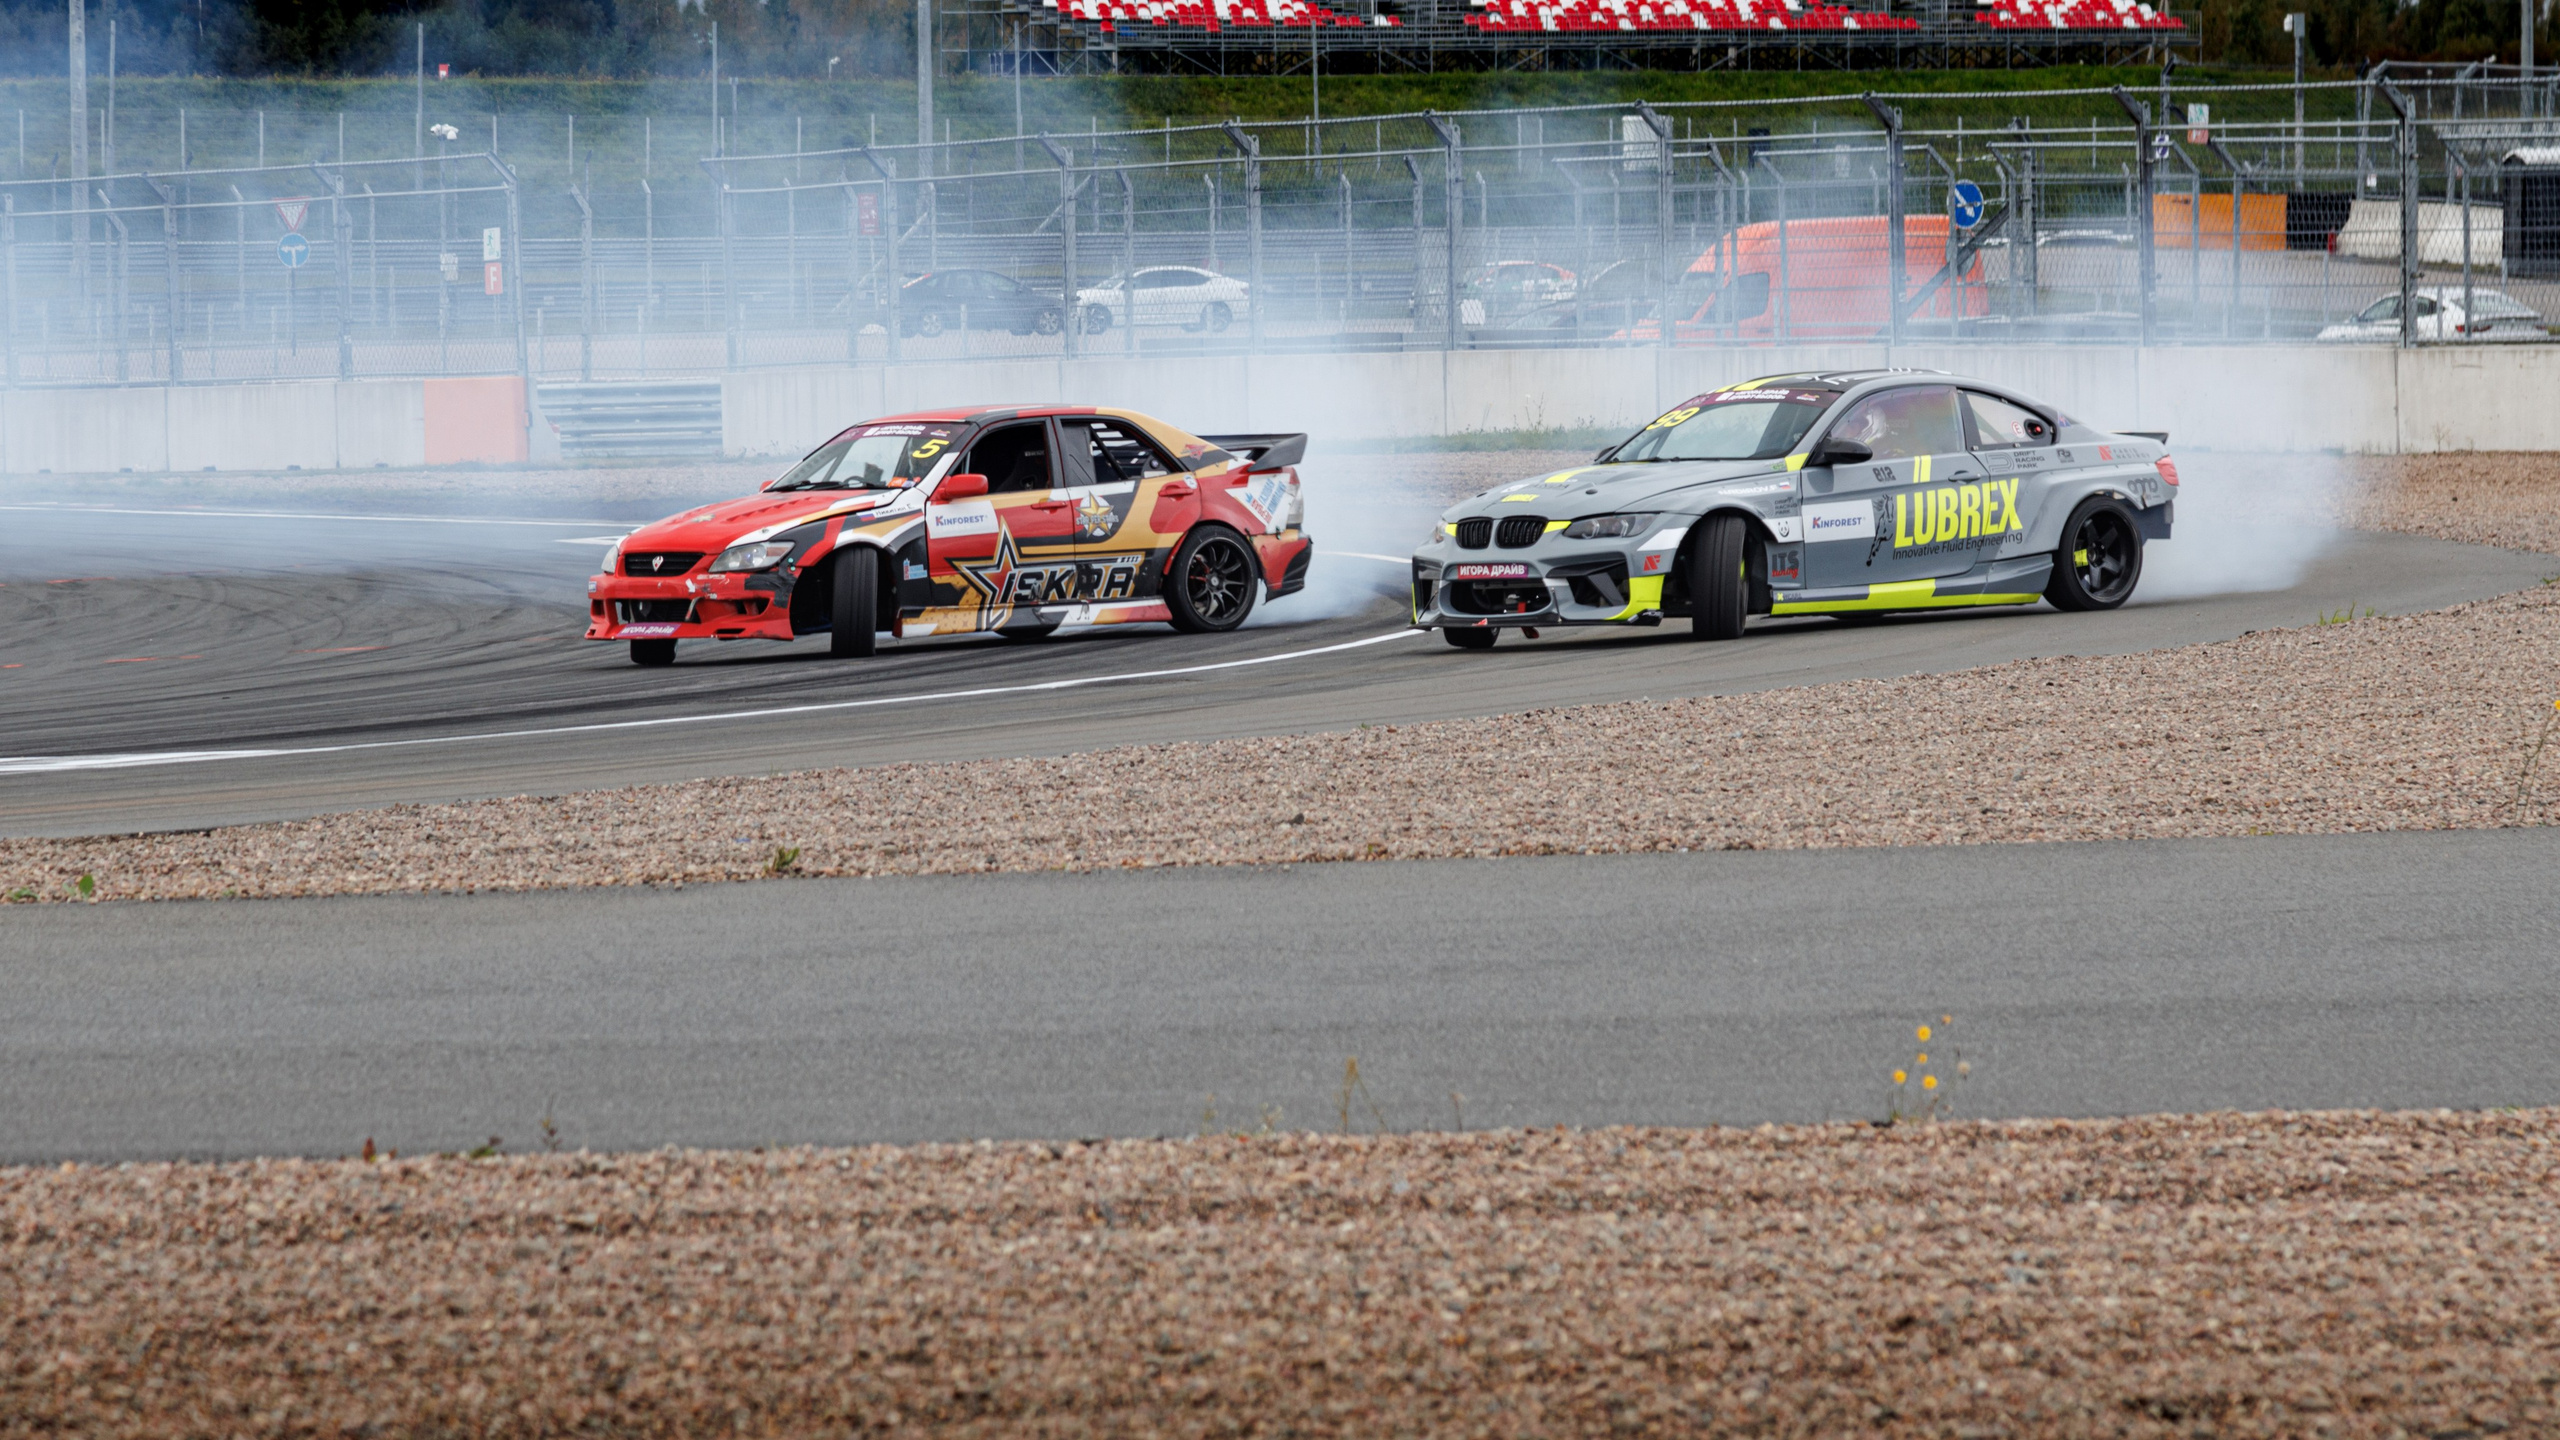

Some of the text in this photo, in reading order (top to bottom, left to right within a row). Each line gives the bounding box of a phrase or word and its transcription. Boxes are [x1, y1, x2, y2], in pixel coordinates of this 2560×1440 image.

[490, 266, 497, 291] F
[1646, 407, 1700, 431] 99
[912, 439, 950, 459] 5
[935, 514, 985, 527] KINFOREST
[1812, 516, 1863, 530] KINFOREST
[1894, 477, 2024, 549] LUBREX
[1892, 531, 2024, 561] Innovative Fluid Engineering
[1459, 562, 1526, 577] ИГОРА ДРАЙВ
[1771, 550, 1800, 571] ITS
[1771, 567, 1799, 580] tuning
[999, 564, 1137, 604] ISKRA
[620, 625, 676, 635] ИГОРА ДРАЙВ
